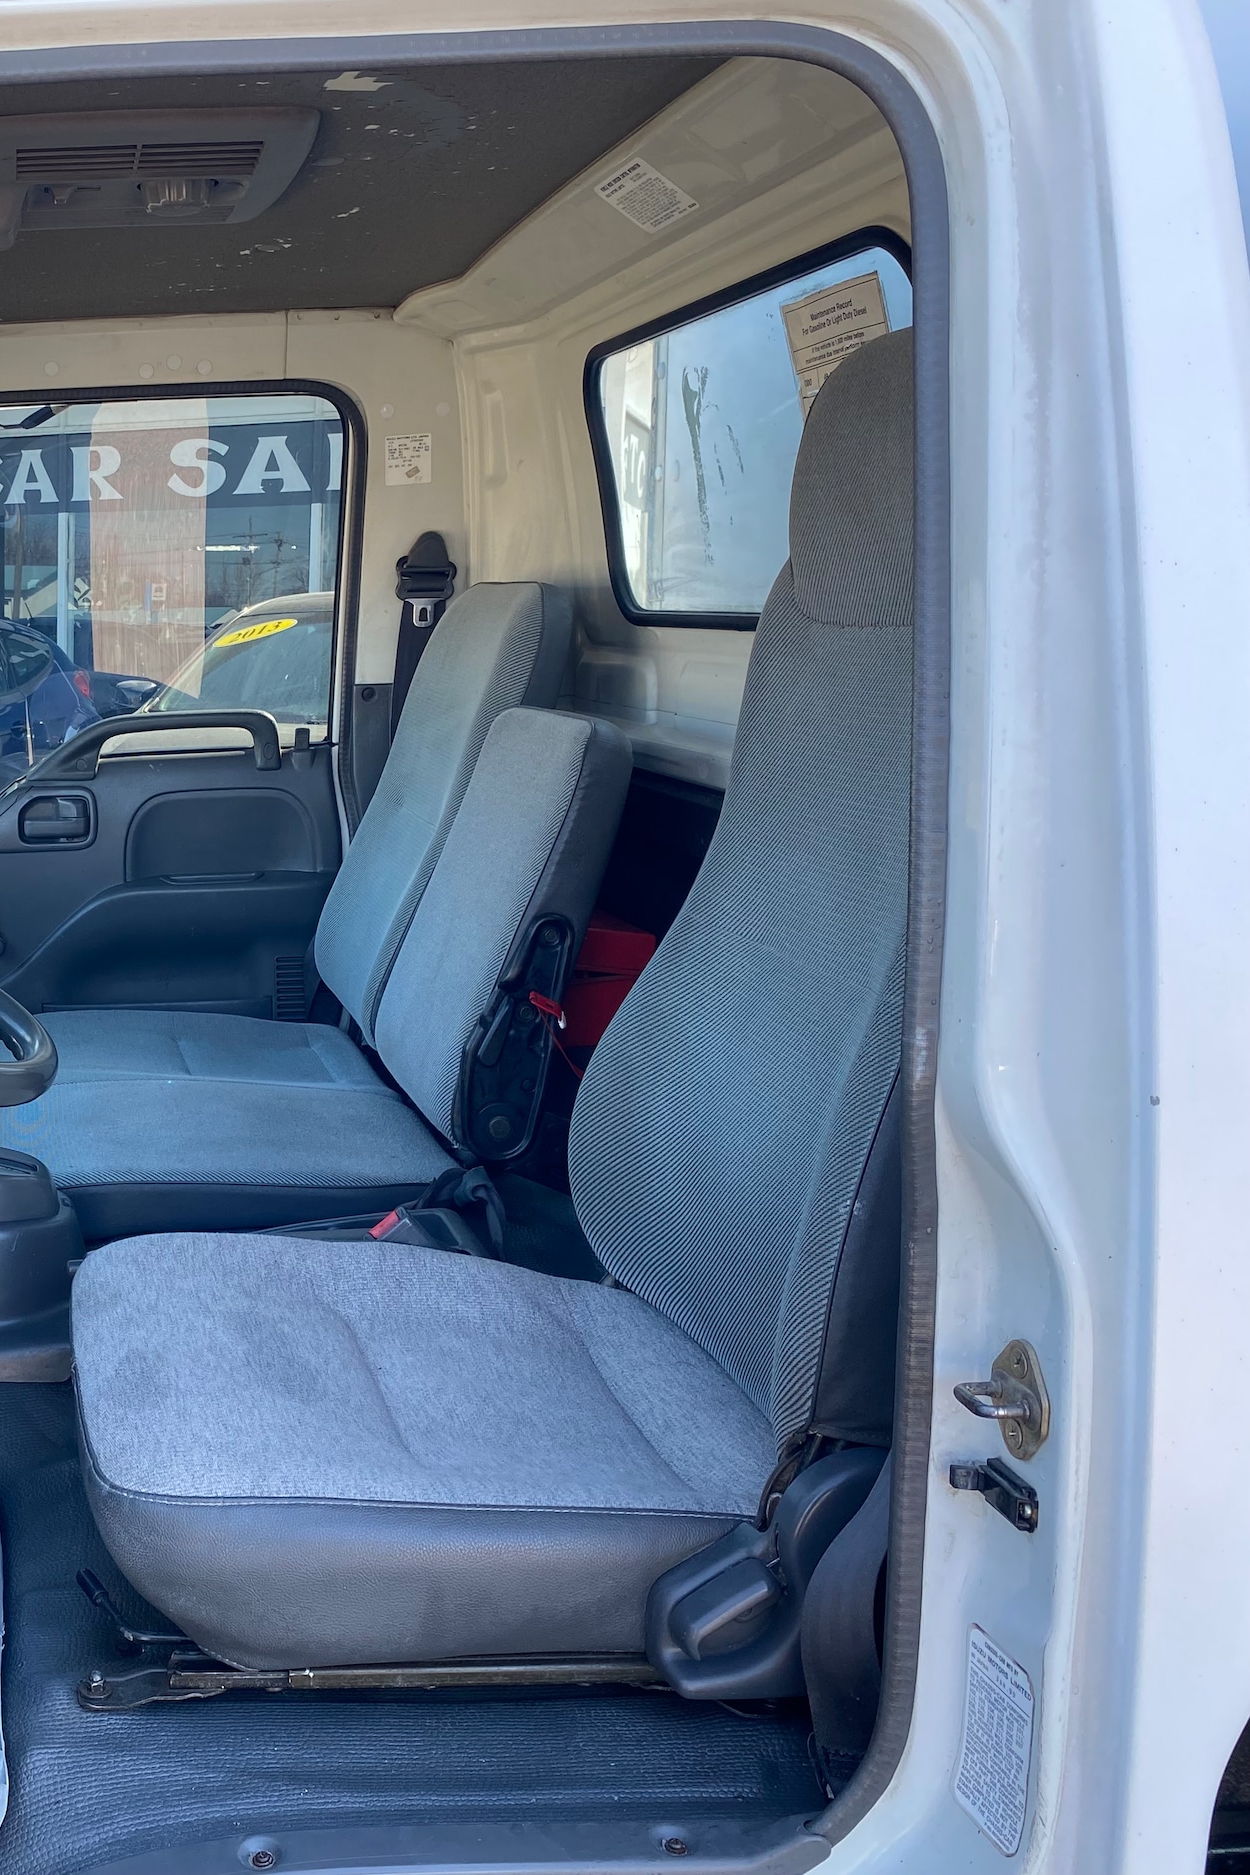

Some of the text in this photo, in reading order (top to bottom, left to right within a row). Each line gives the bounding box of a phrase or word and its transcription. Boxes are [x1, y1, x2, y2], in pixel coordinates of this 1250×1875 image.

[809, 321, 827, 333] Gasoline
[832, 314, 843, 325] Light
[842, 311, 854, 321] Duty
[853, 306, 867, 317] Diesel
[810, 299, 853, 320] Maintenance Record
[228, 621, 283, 643] 2013
[971, 1640, 986, 1659] ISUZU
[987, 1655, 1008, 1681] MOTORS
[1010, 1677, 1031, 1702] LIMITED
